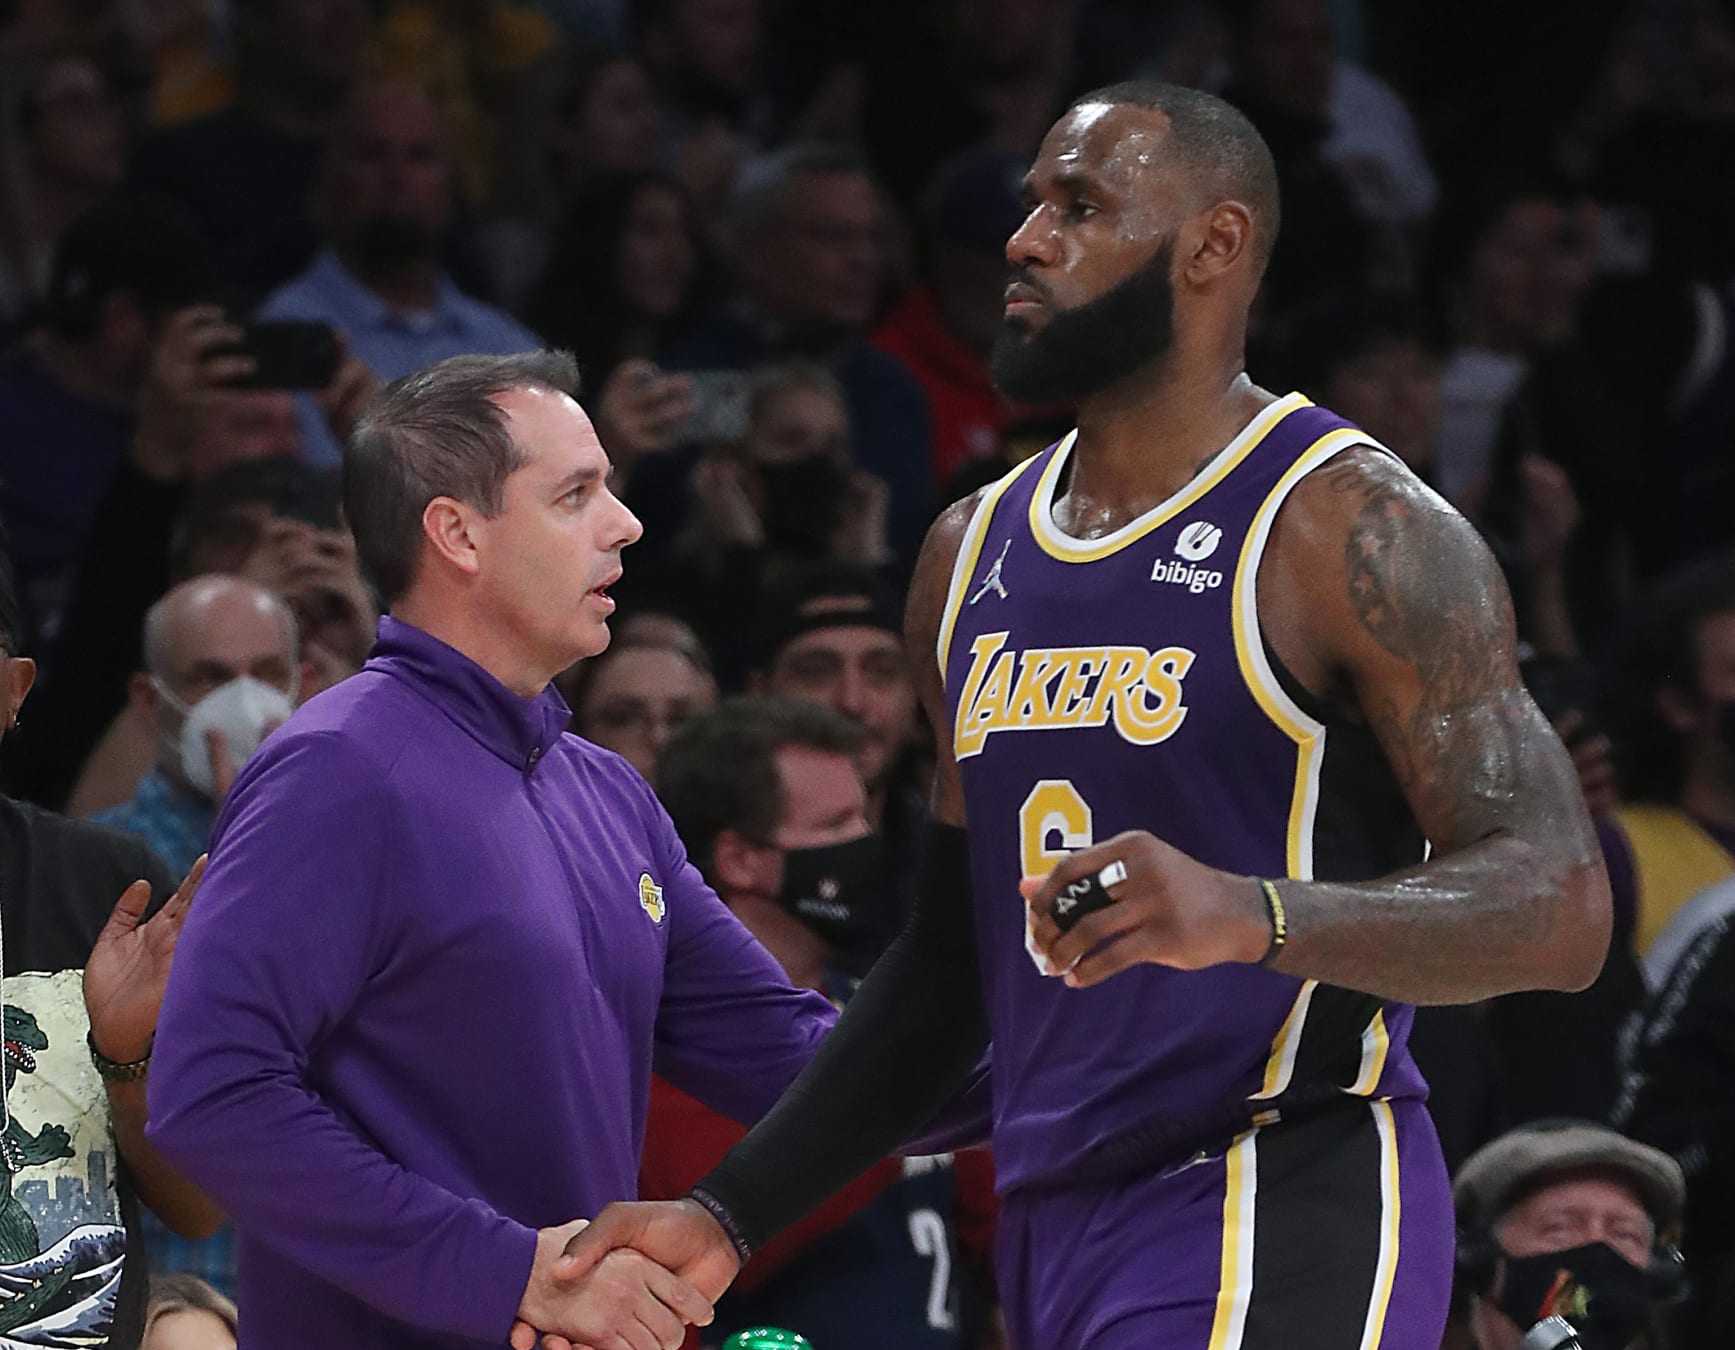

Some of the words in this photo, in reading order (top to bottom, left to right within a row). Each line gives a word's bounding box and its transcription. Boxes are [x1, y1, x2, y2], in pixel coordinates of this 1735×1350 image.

[1151, 558, 1223, 593] bibigo
[953, 630, 1197, 762] LAKERS
[1056, 878, 1092, 915] 24
